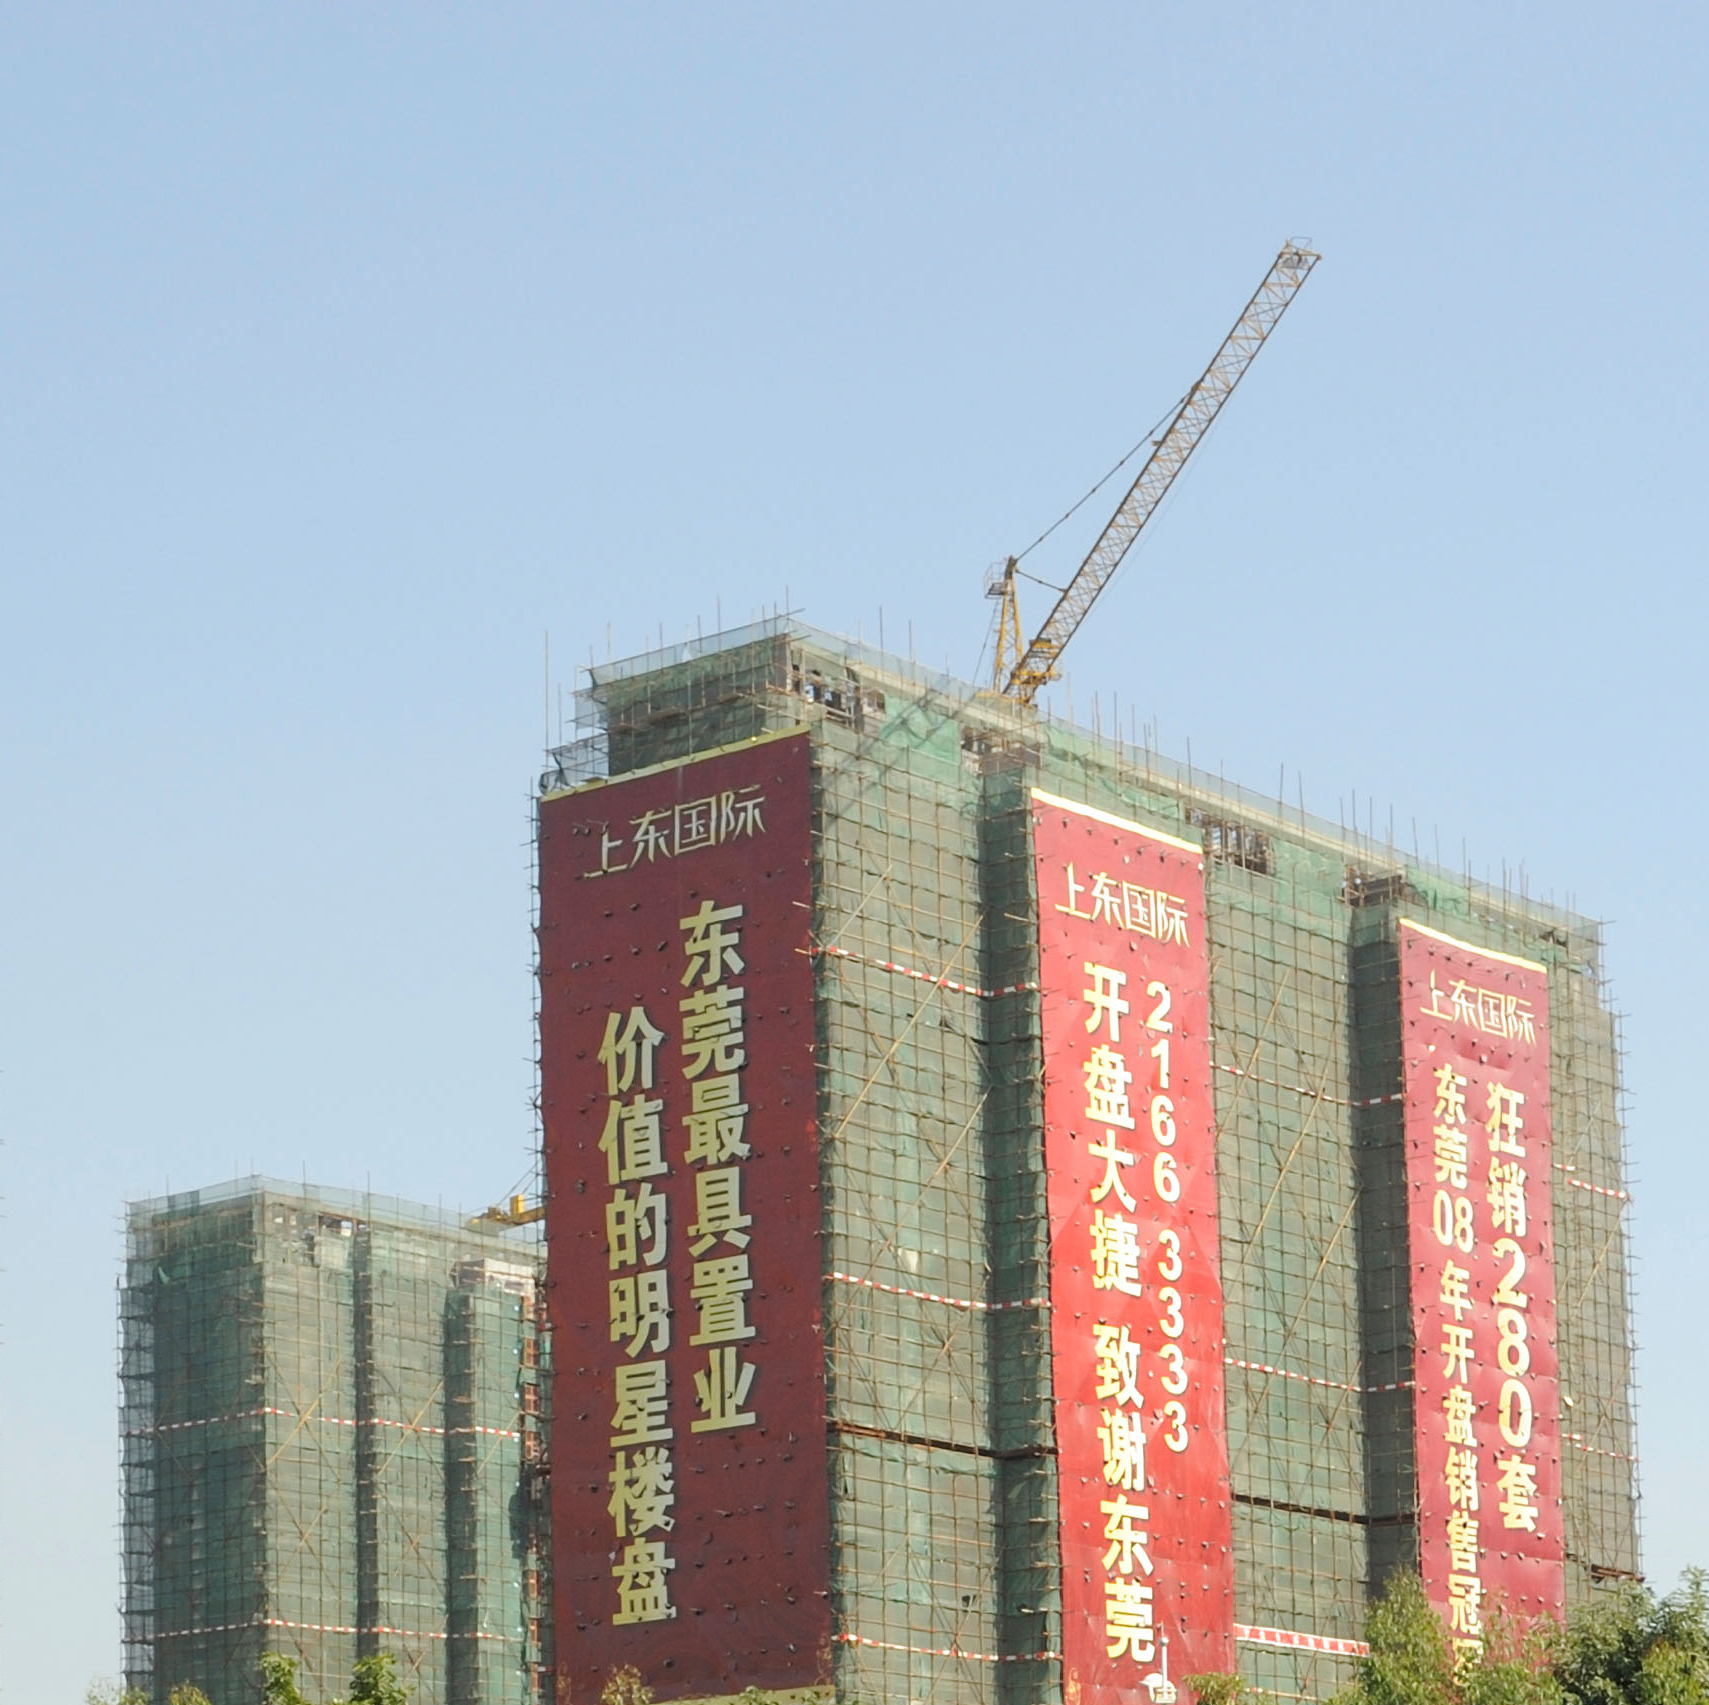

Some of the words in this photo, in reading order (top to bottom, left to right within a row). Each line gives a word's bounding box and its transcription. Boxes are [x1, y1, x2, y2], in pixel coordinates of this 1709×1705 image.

[584, 788, 767, 878] 上东国际
[1054, 862, 1189, 948] 上东国际
[1419, 970, 1538, 1045] 上东国际
[679, 900, 756, 1433] 东莞最具置业
[597, 1005, 676, 1627] 价值的明星楼盘
[1485, 1081, 1539, 1534] 狂销280套
